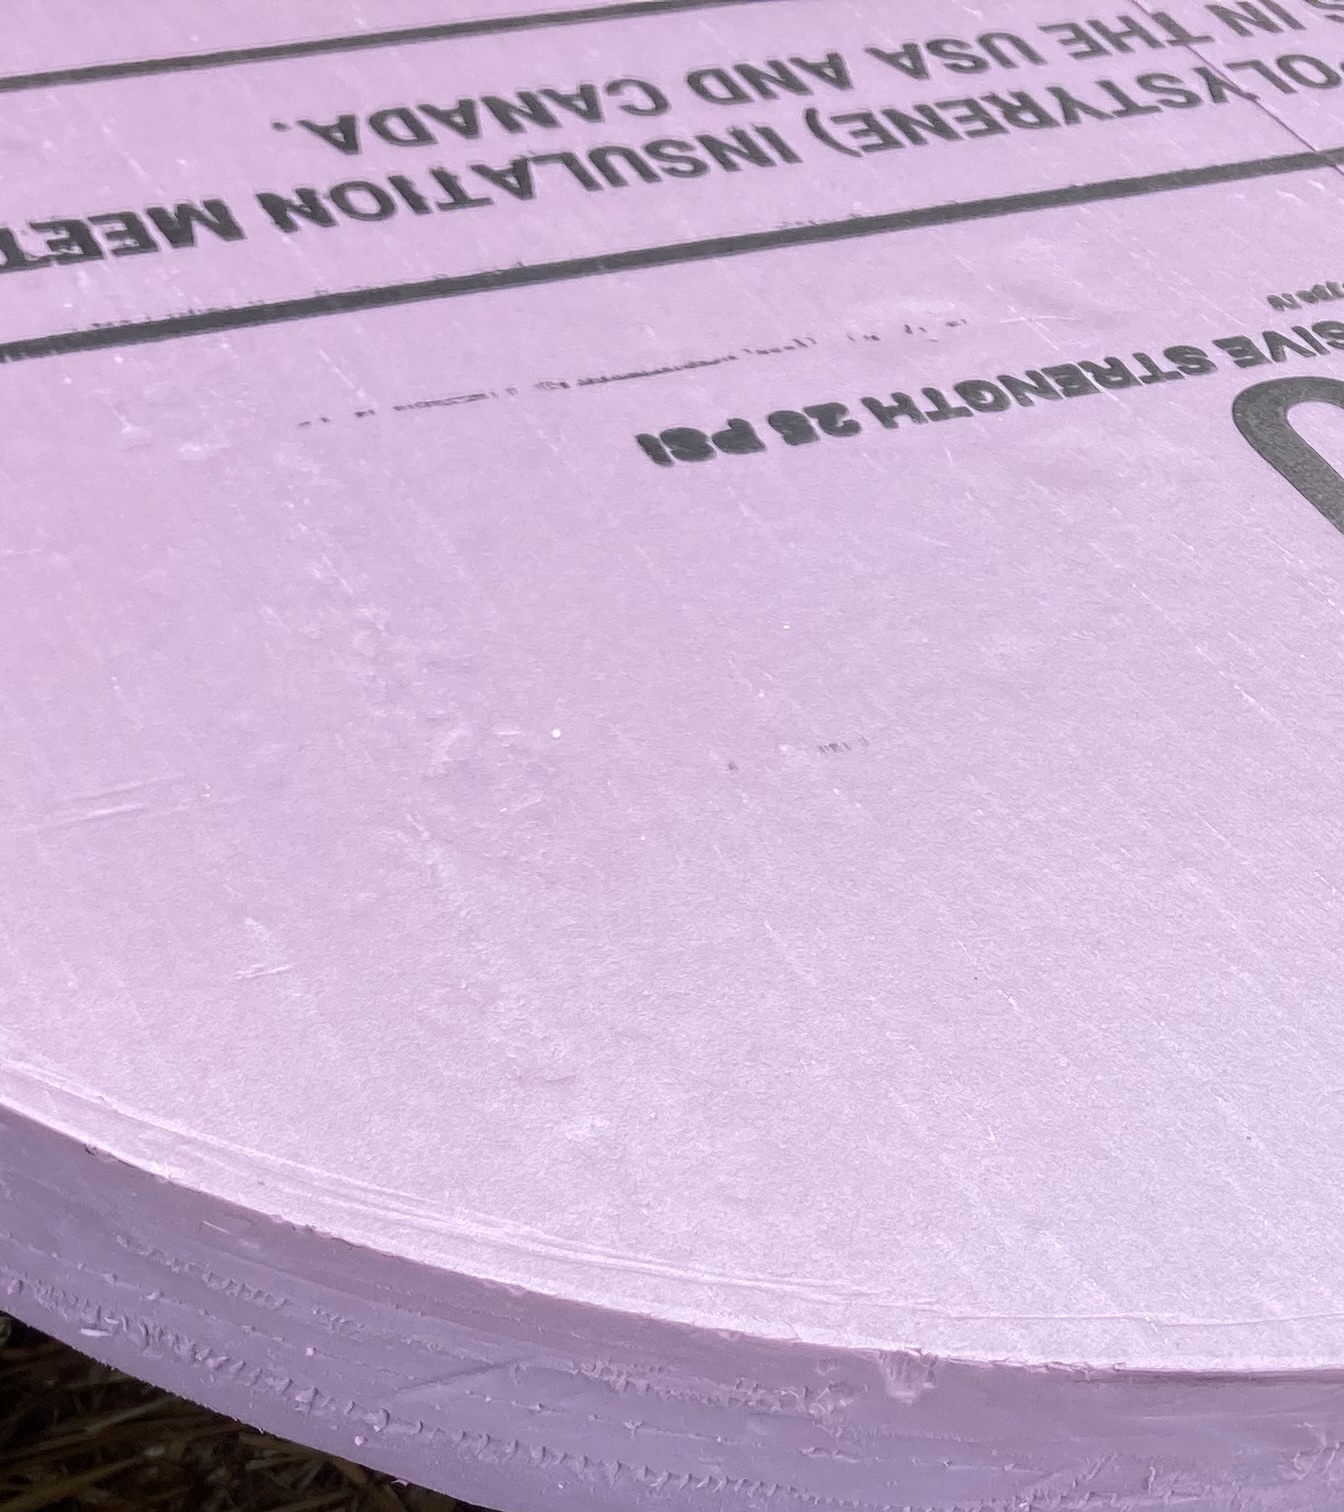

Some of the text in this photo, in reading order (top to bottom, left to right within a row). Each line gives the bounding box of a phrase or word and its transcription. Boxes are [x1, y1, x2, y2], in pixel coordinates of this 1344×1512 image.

[1039, 12, 1213, 61] THE
[1215, 2, 1306, 35] IN
[686, 52, 852, 102] AND
[865, 32, 1049, 80] USA
[272, 76, 670, 155] CANADA.
[256, 123, 802, 234] INSULATION
[860, 344, 1220, 430] STRENGTH
[634, 418, 767, 468] PSI
[766, 401, 862, 447] 25
